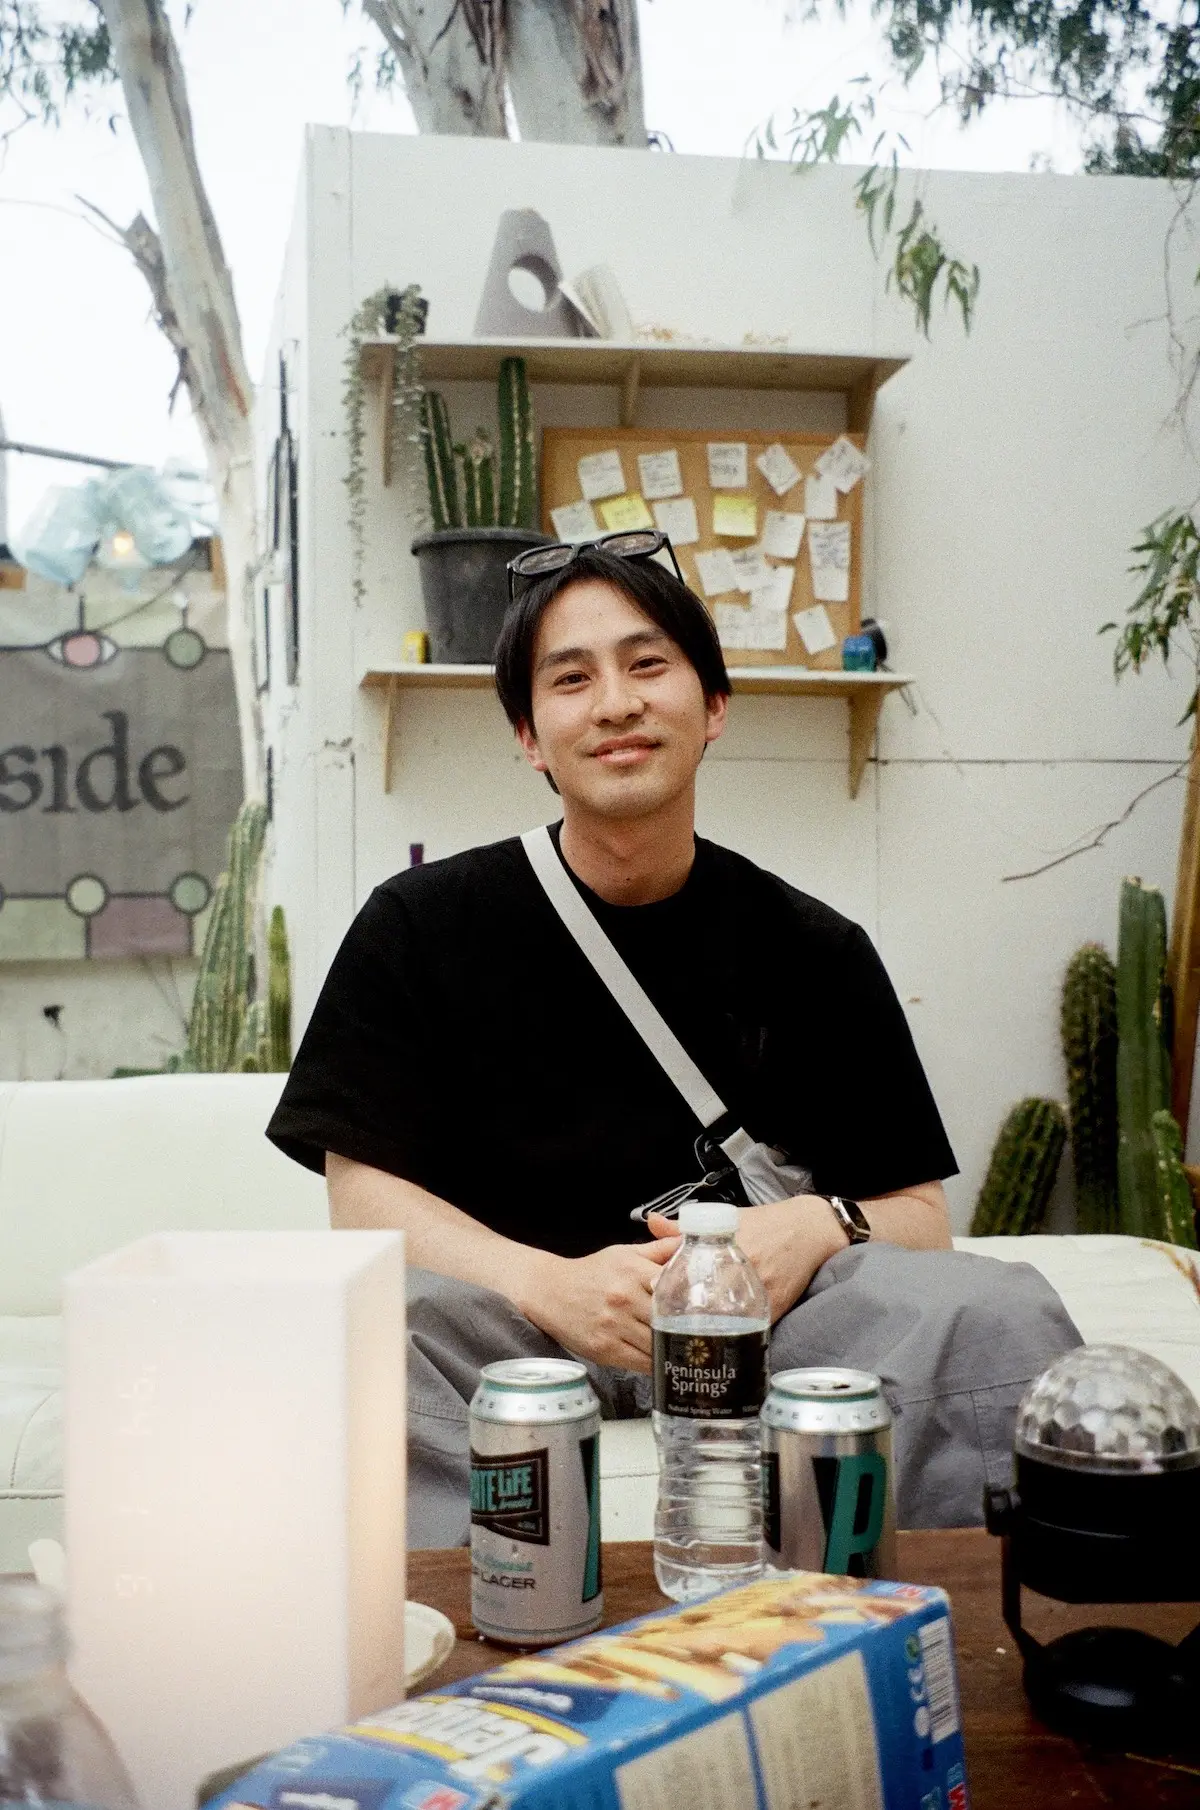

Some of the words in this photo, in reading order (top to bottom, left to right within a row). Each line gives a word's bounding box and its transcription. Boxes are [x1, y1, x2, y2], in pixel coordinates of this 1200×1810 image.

[664, 1360, 736, 1379] Peninsula
[672, 1373, 731, 1398] Springs
[690, 1406, 711, 1416] Spring
[711, 1407, 732, 1415] Water
[481, 1570, 536, 1589] LAGER
